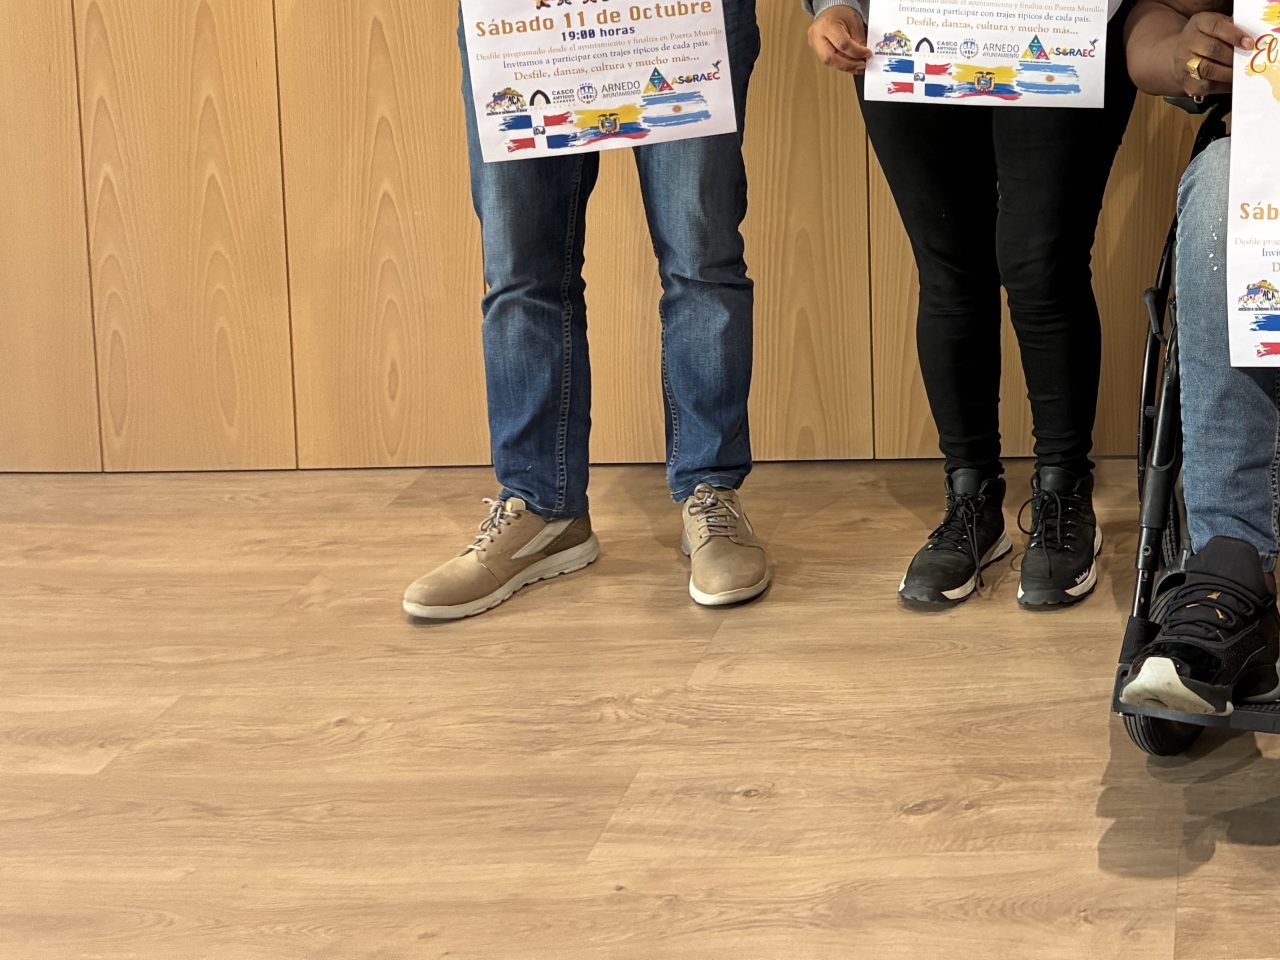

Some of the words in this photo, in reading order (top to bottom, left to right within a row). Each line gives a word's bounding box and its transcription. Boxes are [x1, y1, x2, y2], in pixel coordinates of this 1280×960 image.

[476, 16, 554, 36] Sábado
[565, 12, 585, 28] 11
[597, 10, 620, 24] de
[630, 1, 711, 20] Octubre
[562, 30, 595, 40] 19:00
[600, 27, 635, 36] horas
[983, 43, 1019, 53] ARNEDO
[1249, 34, 1277, 73] El
[602, 81, 640, 92] ARNEDO
